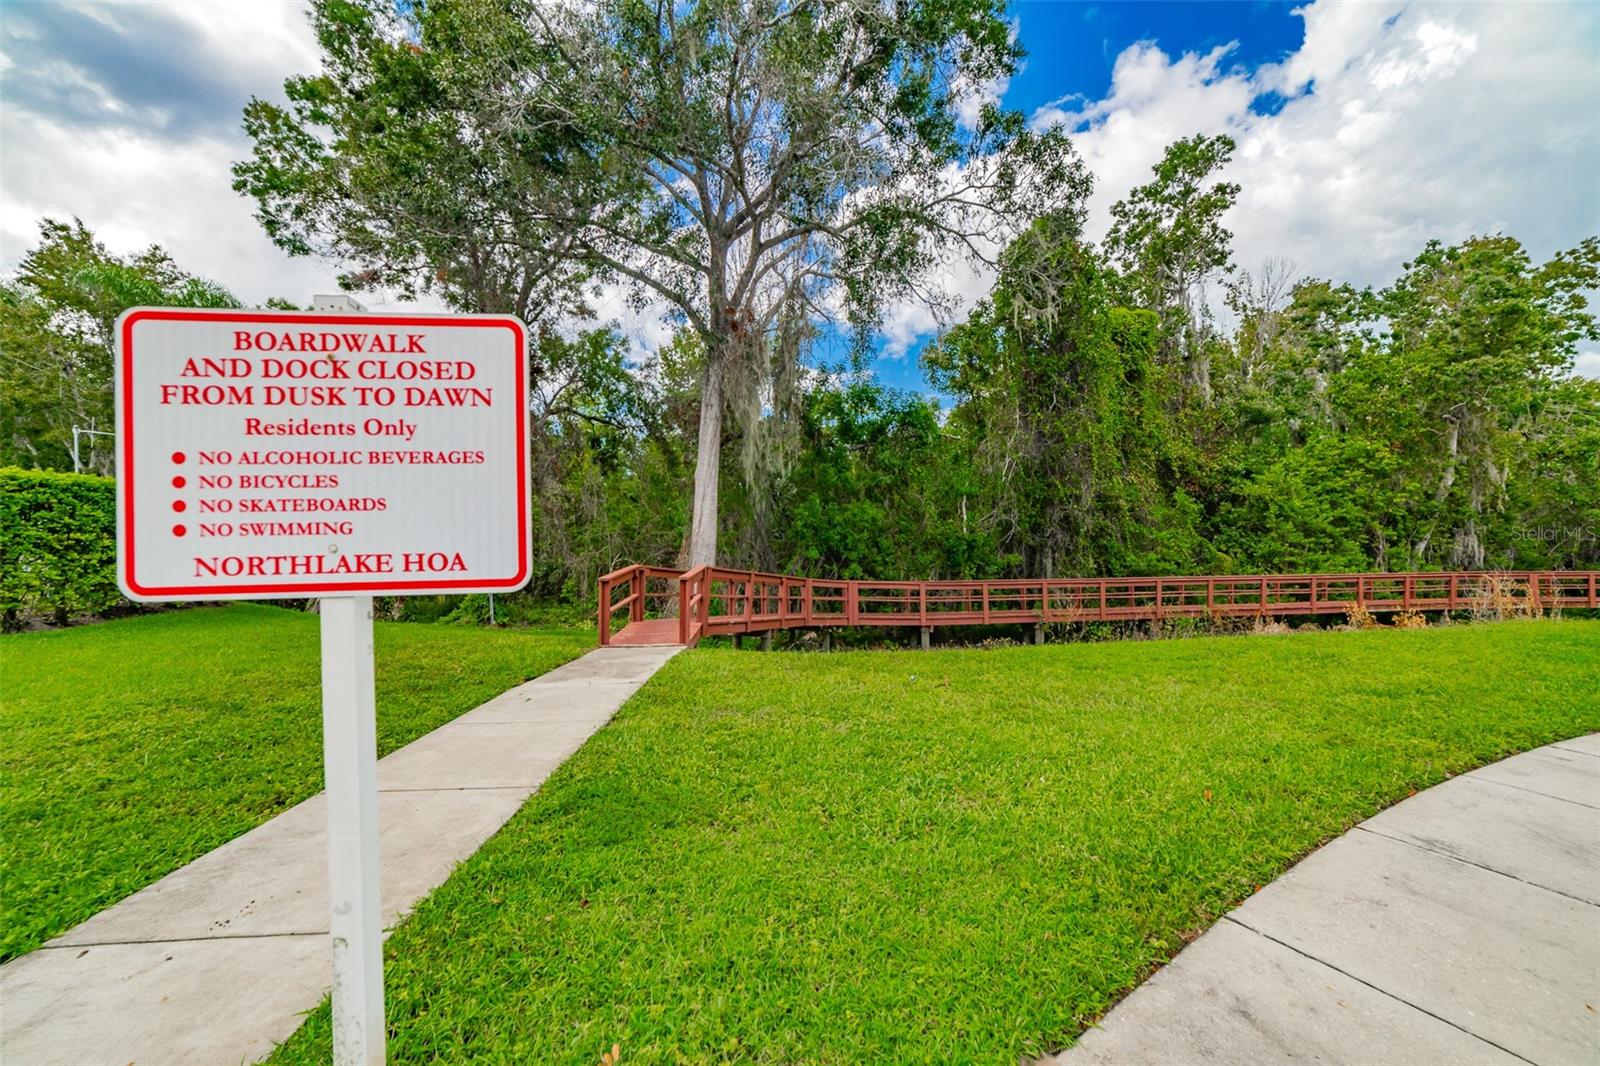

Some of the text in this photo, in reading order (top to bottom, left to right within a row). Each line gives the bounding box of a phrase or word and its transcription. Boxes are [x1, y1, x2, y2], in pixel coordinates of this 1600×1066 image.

[233, 330, 426, 355] BOARDWALK
[180, 357, 476, 381] AND DOCK CLOSED
[160, 384, 493, 408] FROM DUSK TO DAWN
[244, 417, 416, 441] Residents Only
[199, 450, 485, 466] NO ALCOHOLIC BEVERAGES
[199, 474, 339, 490] NO BICYCLES
[199, 497, 388, 513] NO SKATEBOARDS
[199, 521, 353, 537] NO SWIMMING
[194, 551, 468, 577] NORTHLAKE HOA
